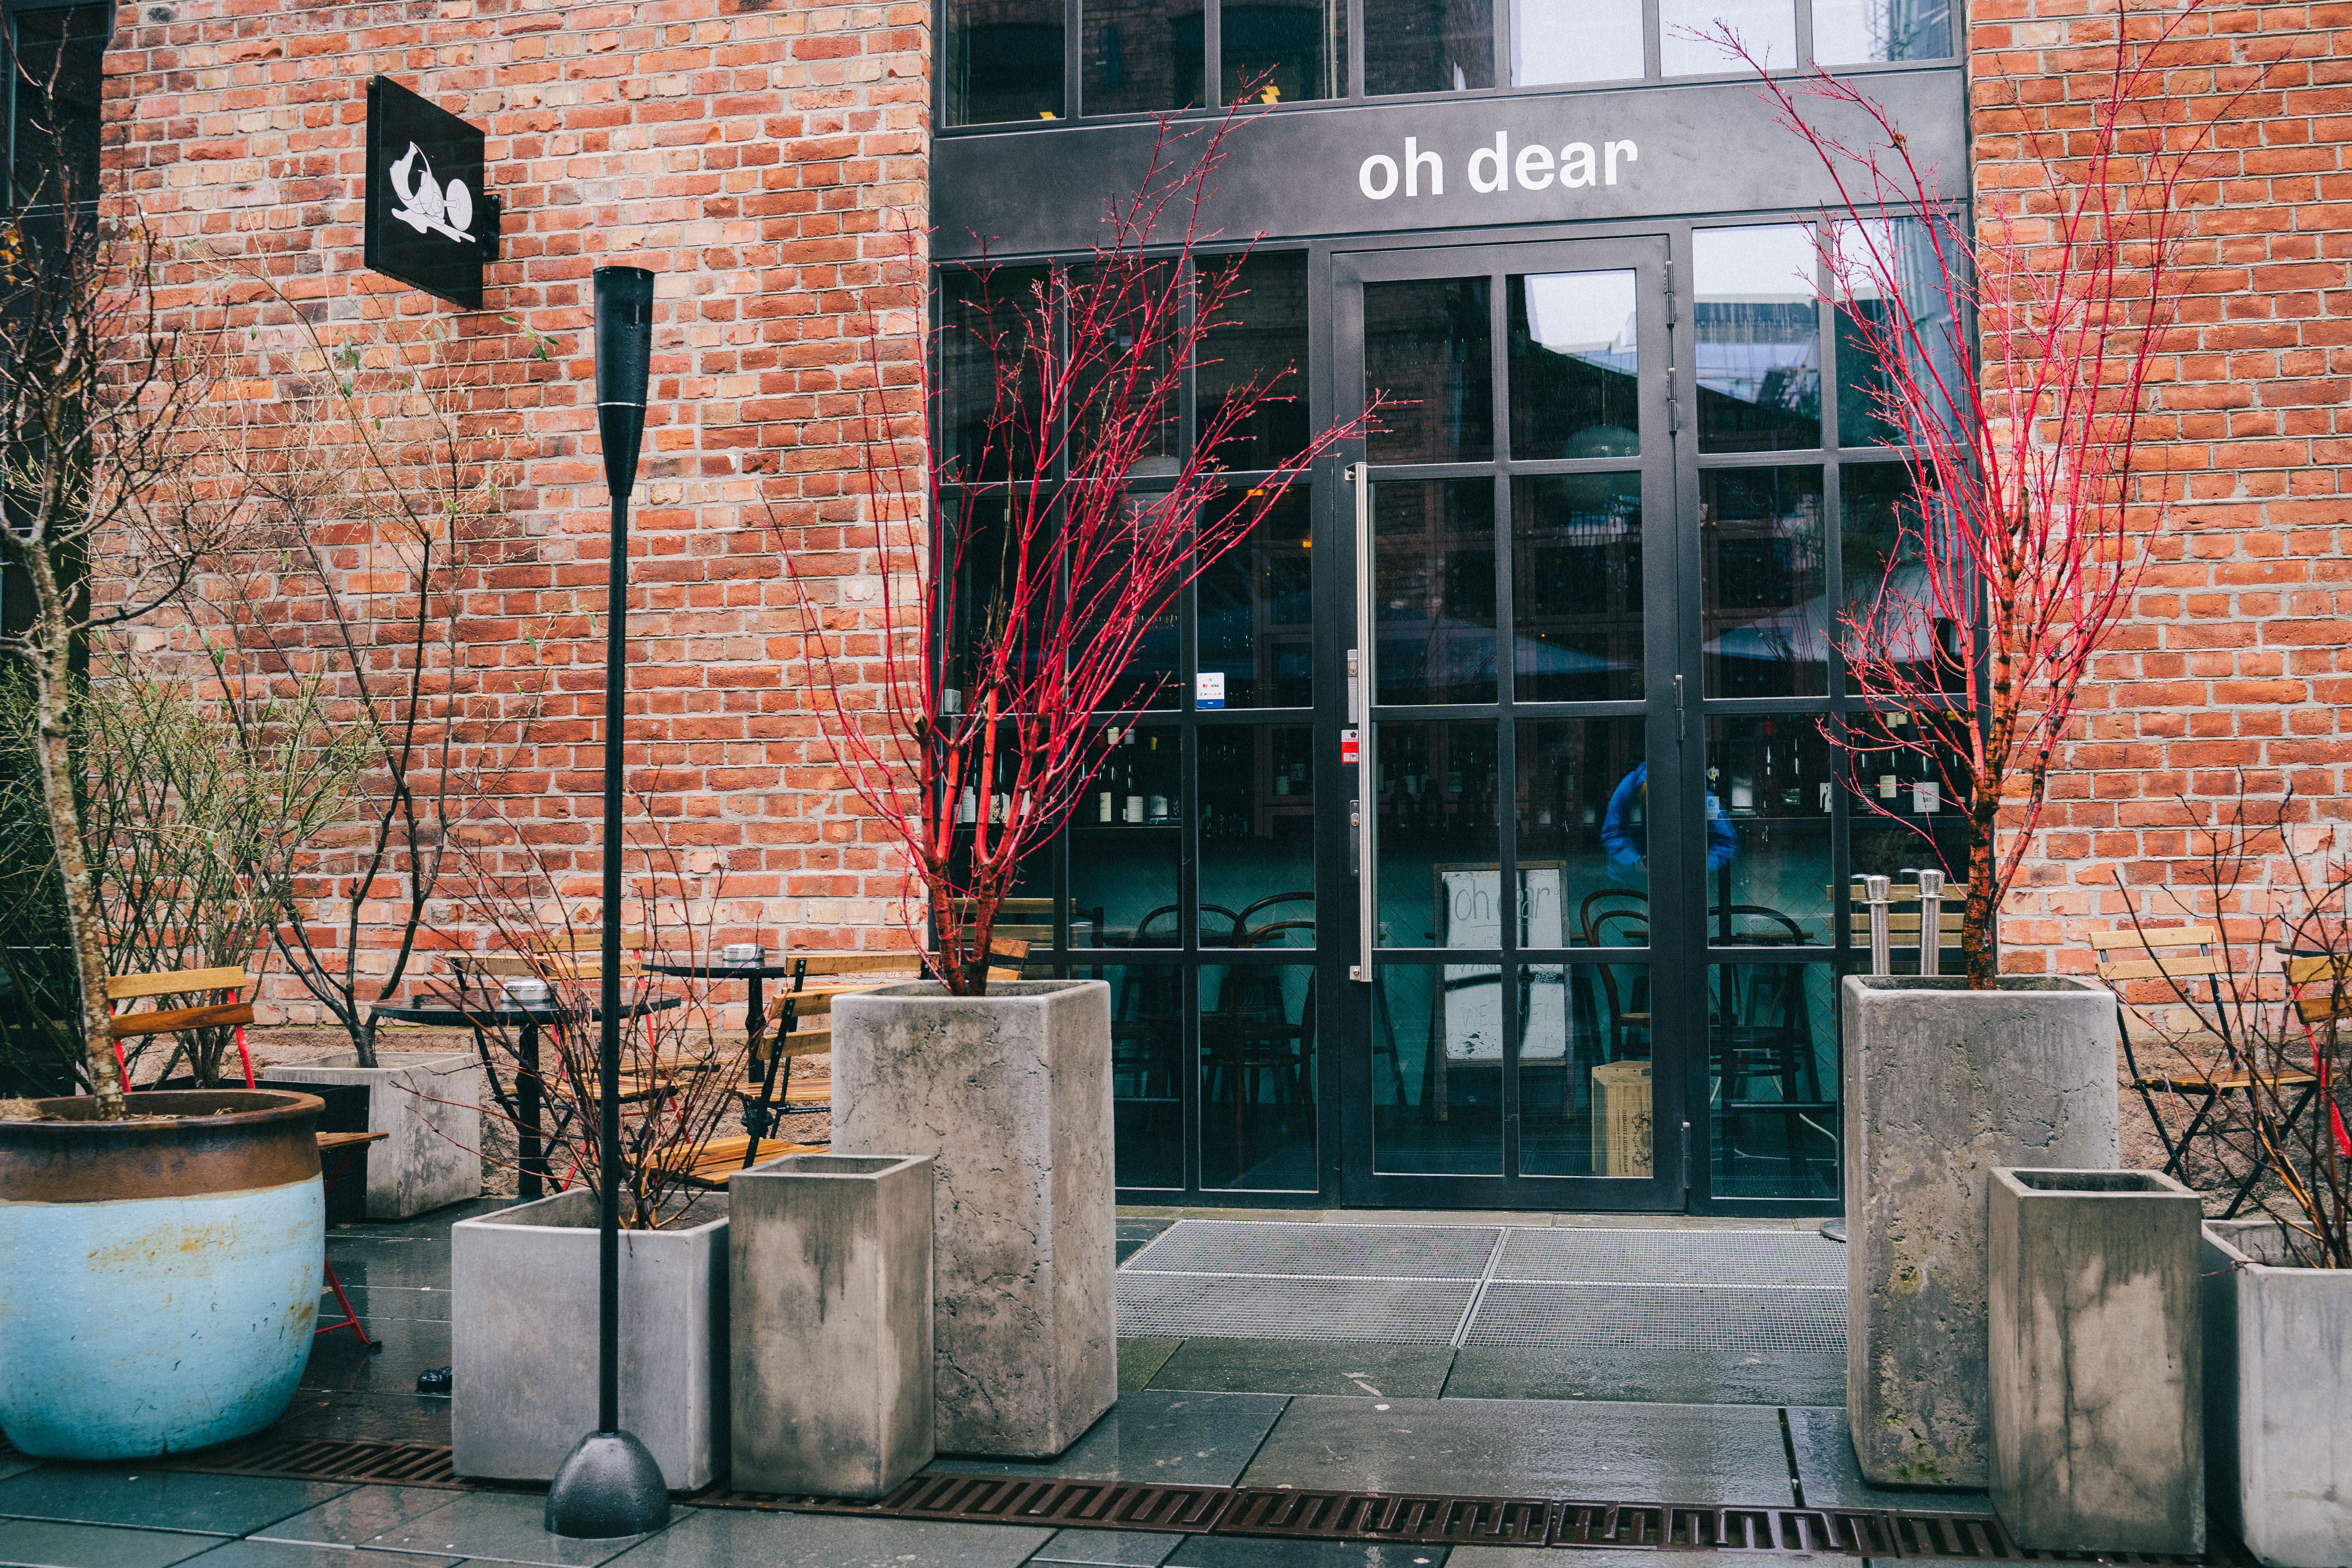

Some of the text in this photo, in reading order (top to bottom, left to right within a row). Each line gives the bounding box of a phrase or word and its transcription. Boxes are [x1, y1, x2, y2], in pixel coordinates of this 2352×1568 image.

[1359, 130, 1638, 200] oh dear
[1455, 879, 1490, 921] oh
